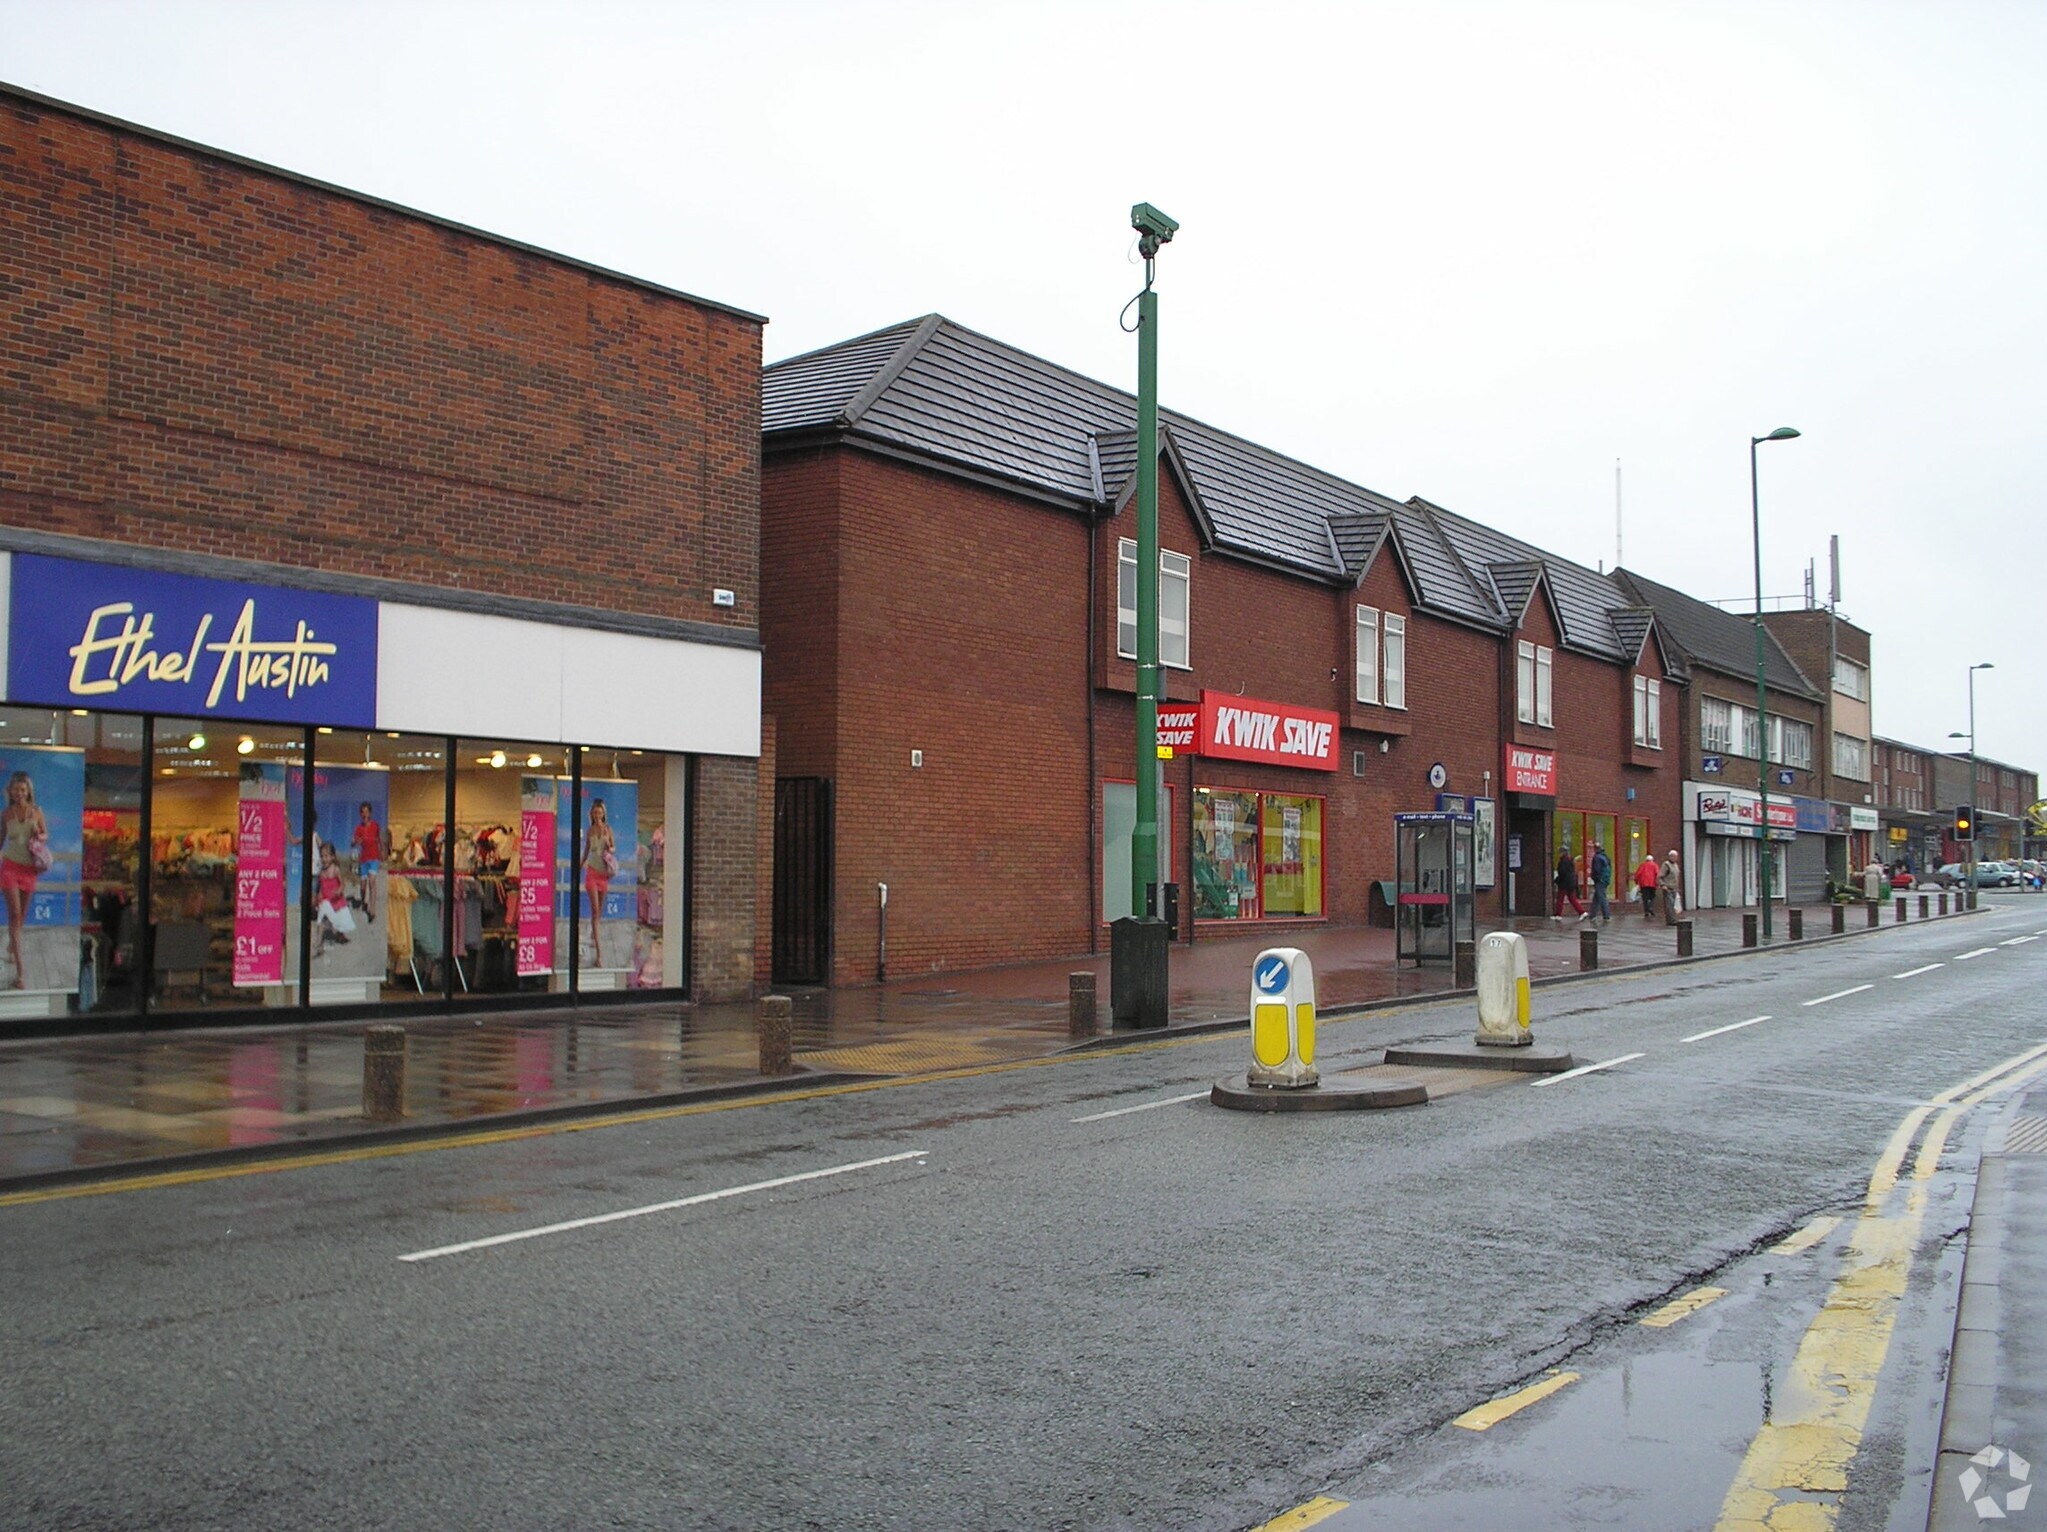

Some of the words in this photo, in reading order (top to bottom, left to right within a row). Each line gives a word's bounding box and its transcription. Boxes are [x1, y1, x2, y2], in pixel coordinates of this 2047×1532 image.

[69, 602, 213, 694] Ethel
[205, 598, 337, 708] Austin
[1157, 730, 1195, 745] SAVE
[1214, 706, 1280, 752] KWIK
[1279, 717, 1333, 758] SAVE
[1511, 750, 1534, 770] KWIK
[1534, 753, 1553, 772] SAVE
[1516, 770, 1548, 790] ENTRANCE
[240, 833, 262, 842] PRICE
[238, 869, 254, 879] ANY
[261, 869, 277, 879] FOR
[238, 879, 259, 899] £7
[520, 887, 536, 905] £5
[35, 905, 50, 920] £4
[607, 903, 618, 914] £4
[236, 935, 256, 956] £1
[257, 944, 274, 954] OFF
[535, 936, 548, 944] FOR
[519, 945, 535, 963] £8
